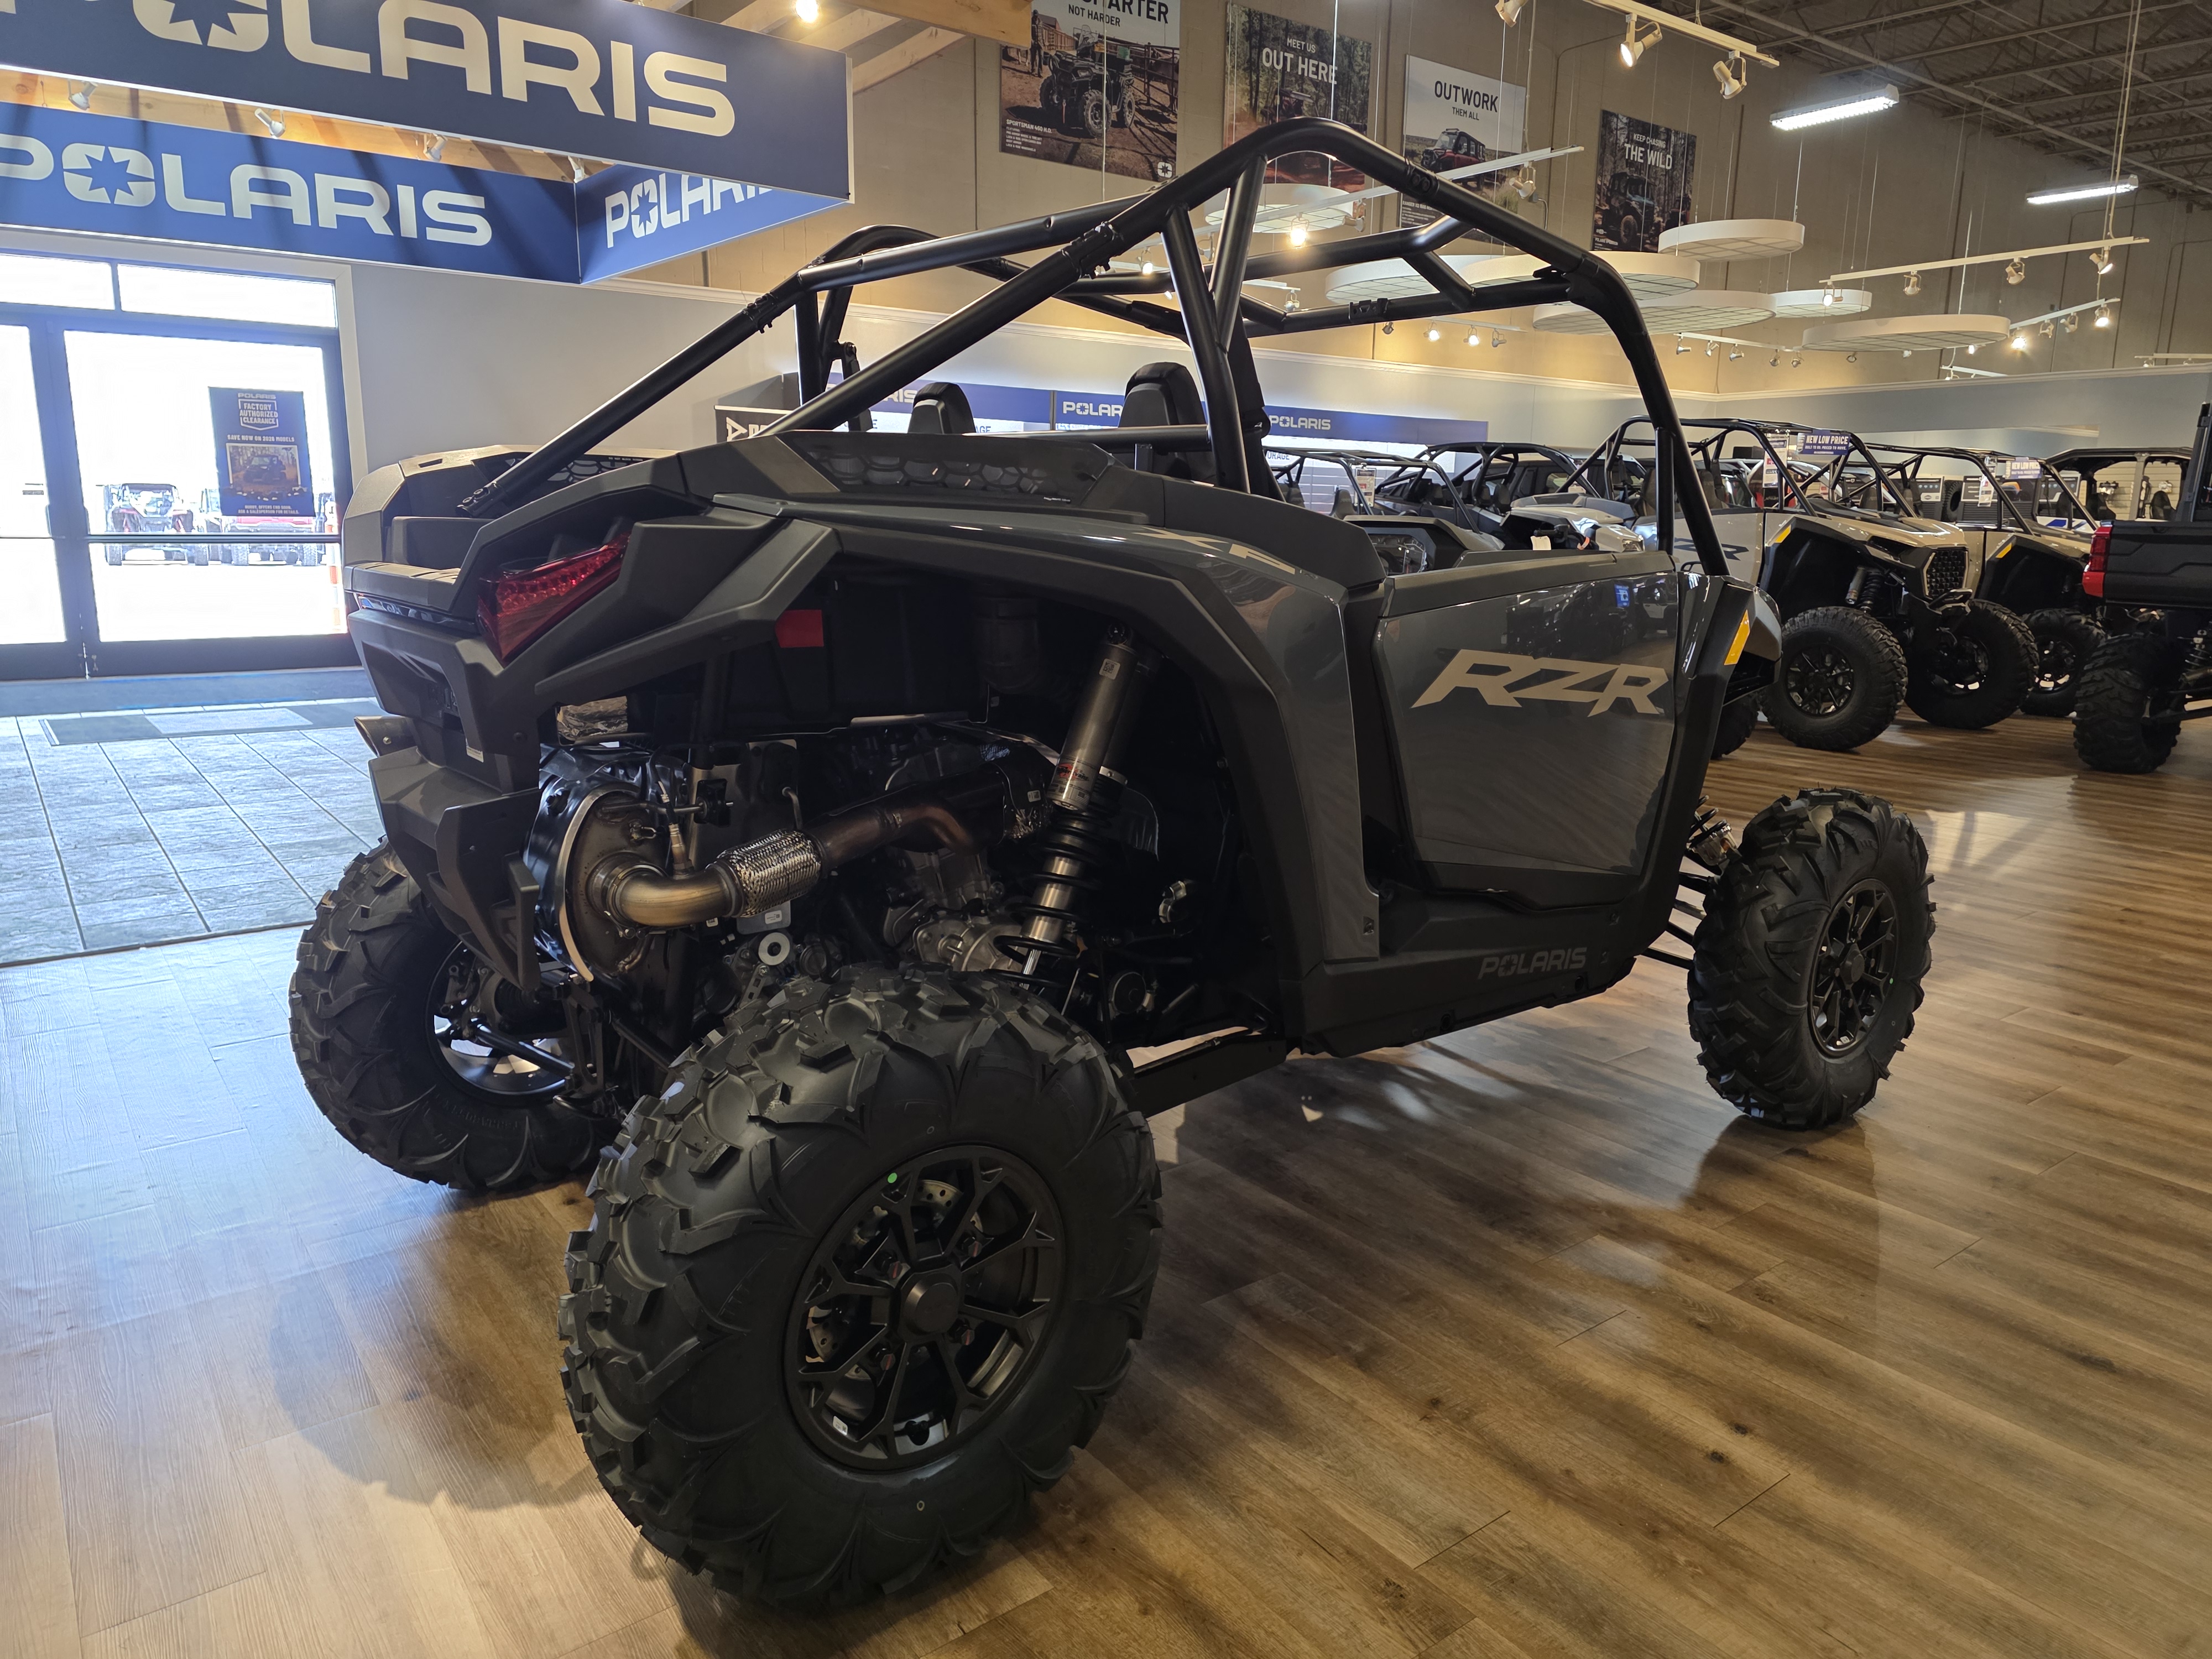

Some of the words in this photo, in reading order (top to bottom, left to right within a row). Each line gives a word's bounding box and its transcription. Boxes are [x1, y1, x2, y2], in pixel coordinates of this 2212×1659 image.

[1068, 4, 1085, 17] NOT
[1087, 9, 1120, 27] HARDER
[1082, 0, 1168, 24] ARTER
[1287, 38, 1305, 50] MEET
[1306, 43, 1316, 54] US
[0, 0, 735, 137] OLARIS
[1262, 48, 1294, 72] OUT
[1298, 56, 1338, 85] HERE
[1434, 80, 1498, 112] OUTWORK
[1006, 119, 1034, 130] SPORTSMAN
[1452, 107, 1467, 118] THEM
[1468, 111, 1479, 121] ALL
[1634, 133, 1646, 142] KEEP
[1646, 137, 1666, 148] CHASING
[1624, 143, 1645, 163] THE
[1647, 149, 1672, 169] WILD
[605, 173, 771, 248] POLA
[1063, 401, 1123, 417] POLAR
[1269, 415, 1331, 430] POLARIS
[1806, 435, 1818, 444] NEW
[1818, 435, 1830, 444] LOW
[1830, 436, 1849, 445] PRICE
[1267, 451, 1290, 460] ORAGE
[1411, 649, 1669, 718] RZR
[1477, 947, 1587, 980] POLARIS
